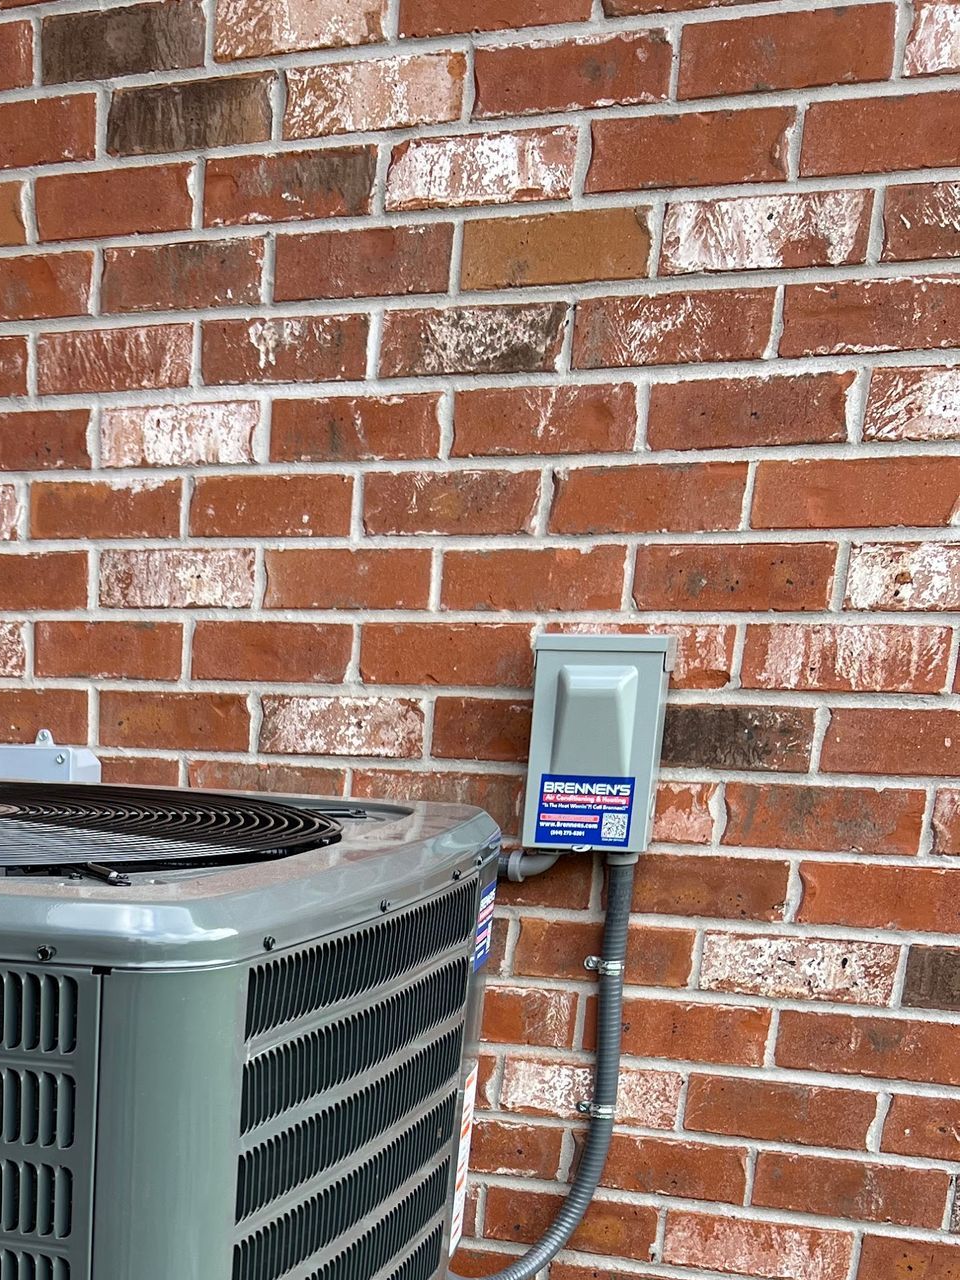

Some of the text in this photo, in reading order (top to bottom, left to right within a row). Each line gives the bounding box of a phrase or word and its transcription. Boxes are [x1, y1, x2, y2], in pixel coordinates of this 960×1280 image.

[543, 781, 631, 795] BRENNEN'S
[556, 795, 595, 803] Conditioning
[602, 796, 627, 805] Heating
